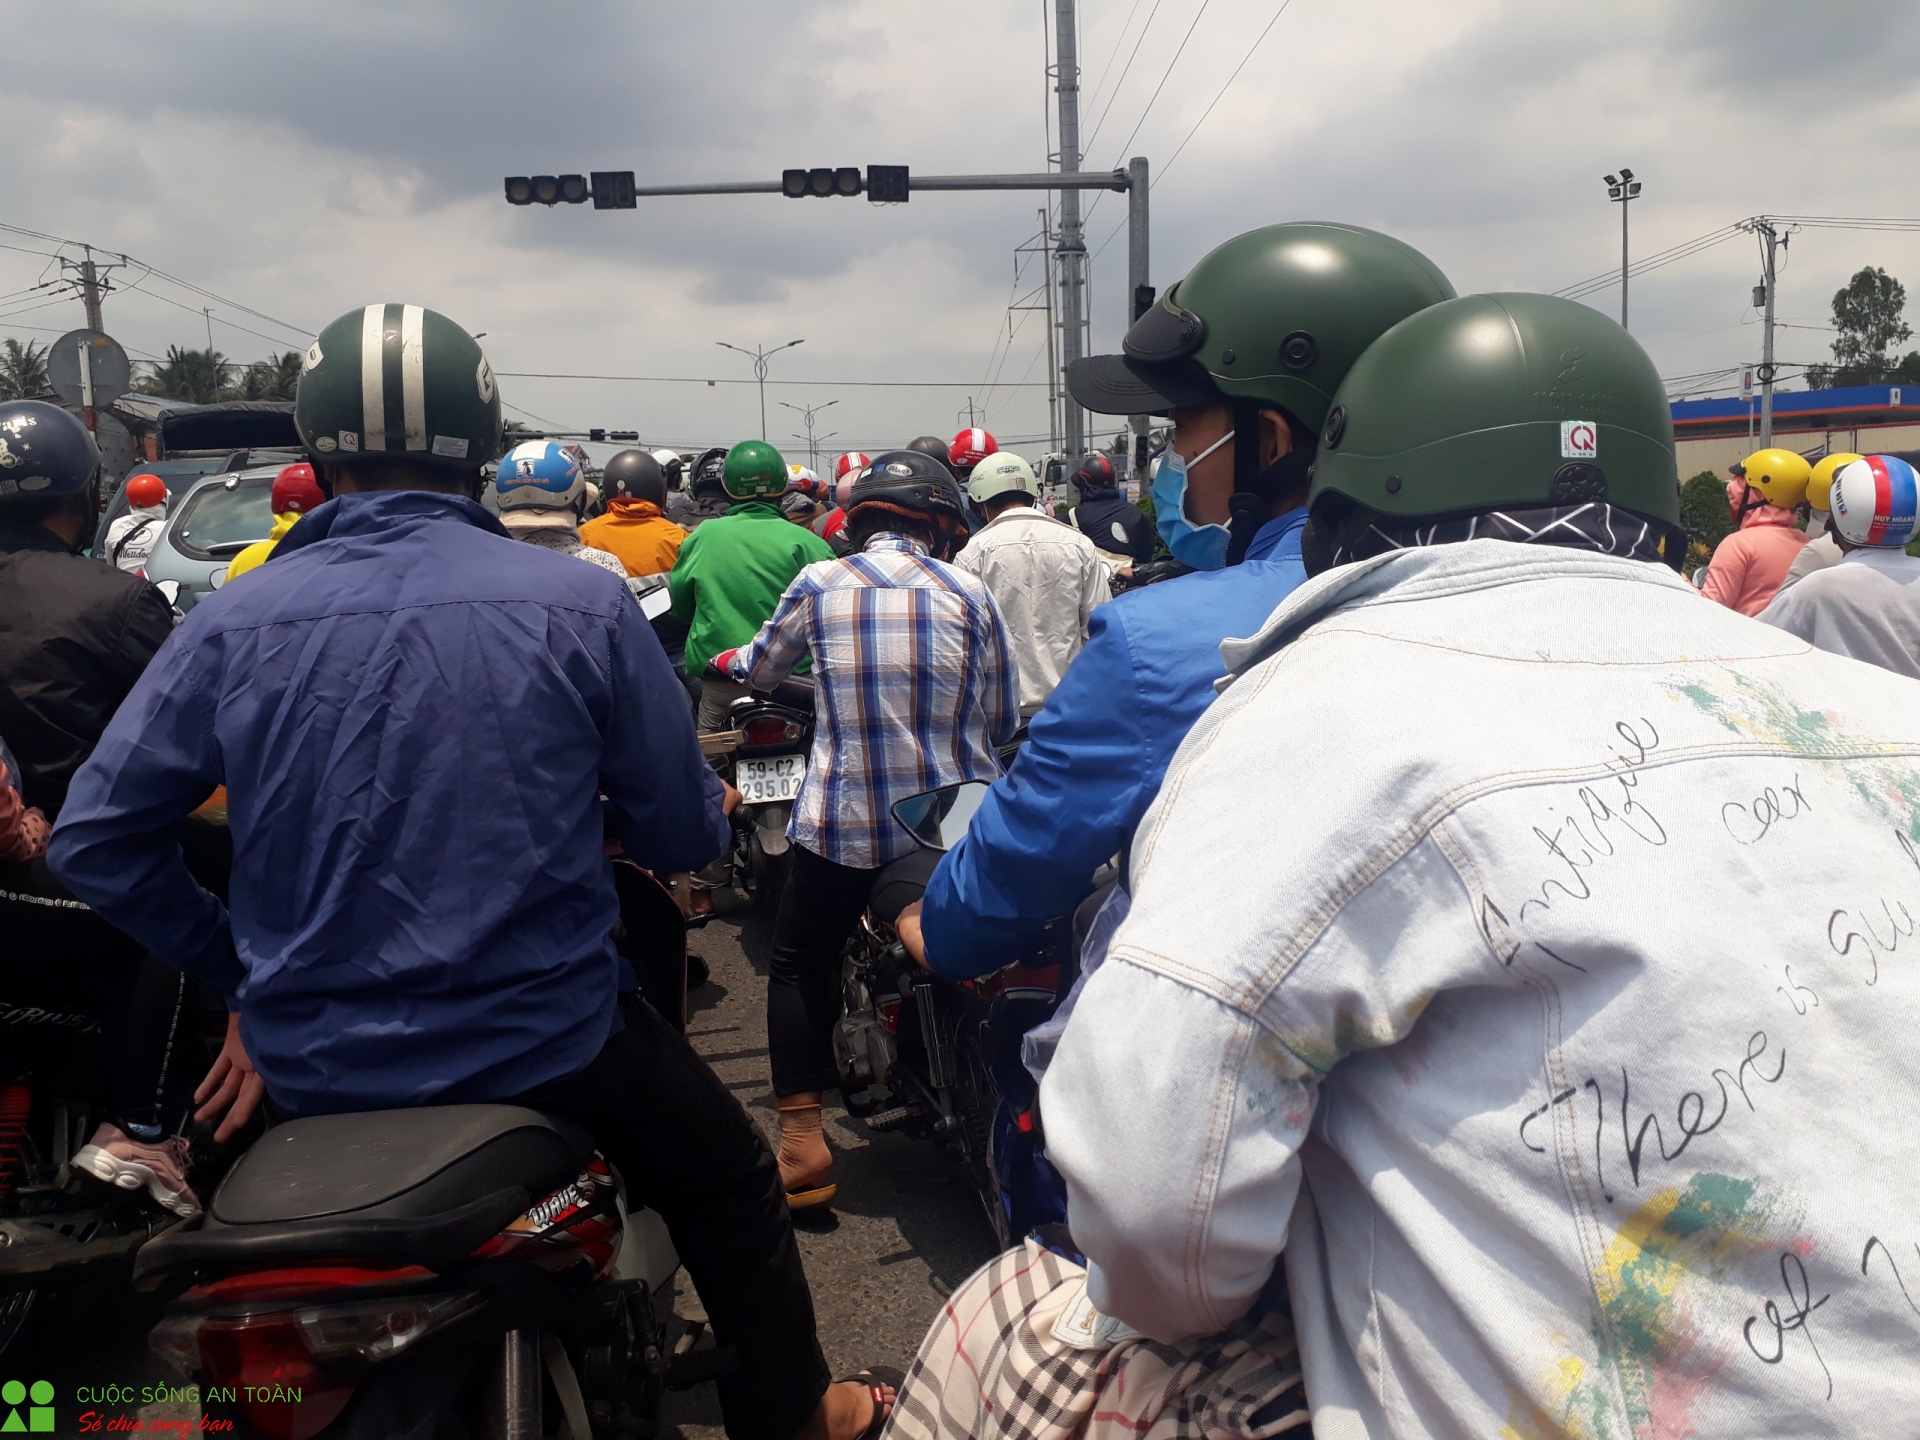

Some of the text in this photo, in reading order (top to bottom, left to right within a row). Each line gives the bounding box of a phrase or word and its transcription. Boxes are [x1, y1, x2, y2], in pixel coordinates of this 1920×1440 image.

[742, 777, 802, 801] 295.02
[747, 758, 795, 781] 59-C2
[1520, 1030, 1787, 1204] There
[525, 1184, 580, 1228] WAVE
[1743, 1252, 1832, 1401] of
